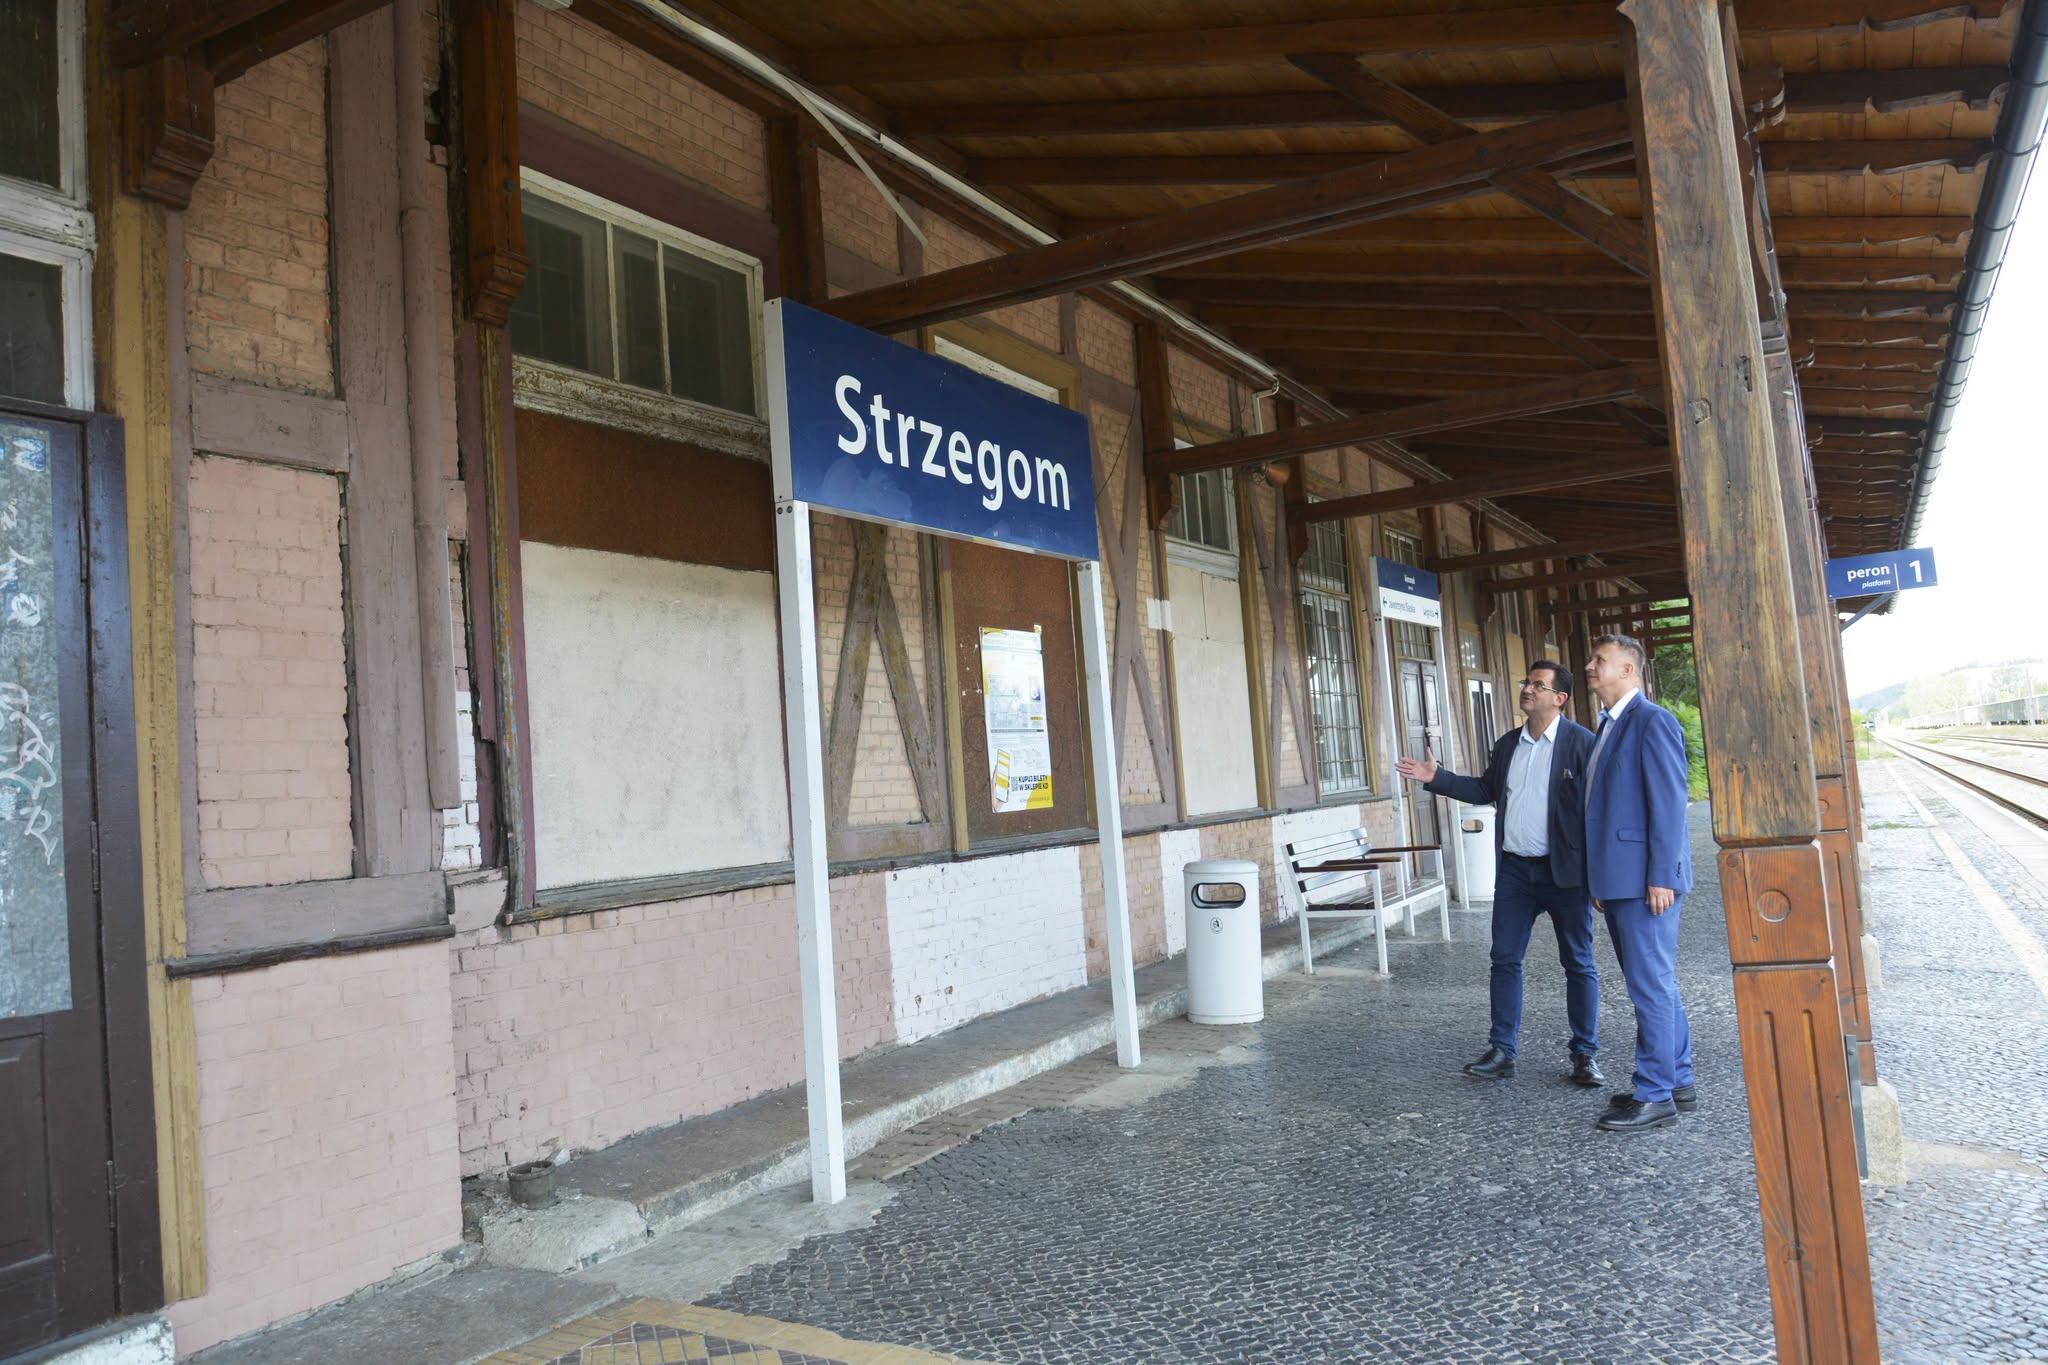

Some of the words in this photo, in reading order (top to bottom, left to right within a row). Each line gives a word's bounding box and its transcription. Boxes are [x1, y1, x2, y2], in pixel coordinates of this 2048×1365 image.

[835, 375, 1071, 511] Strzegom
[1847, 565, 1890, 582] peron
[1909, 560, 1923, 583] 1
[1862, 579, 1891, 589] platform
